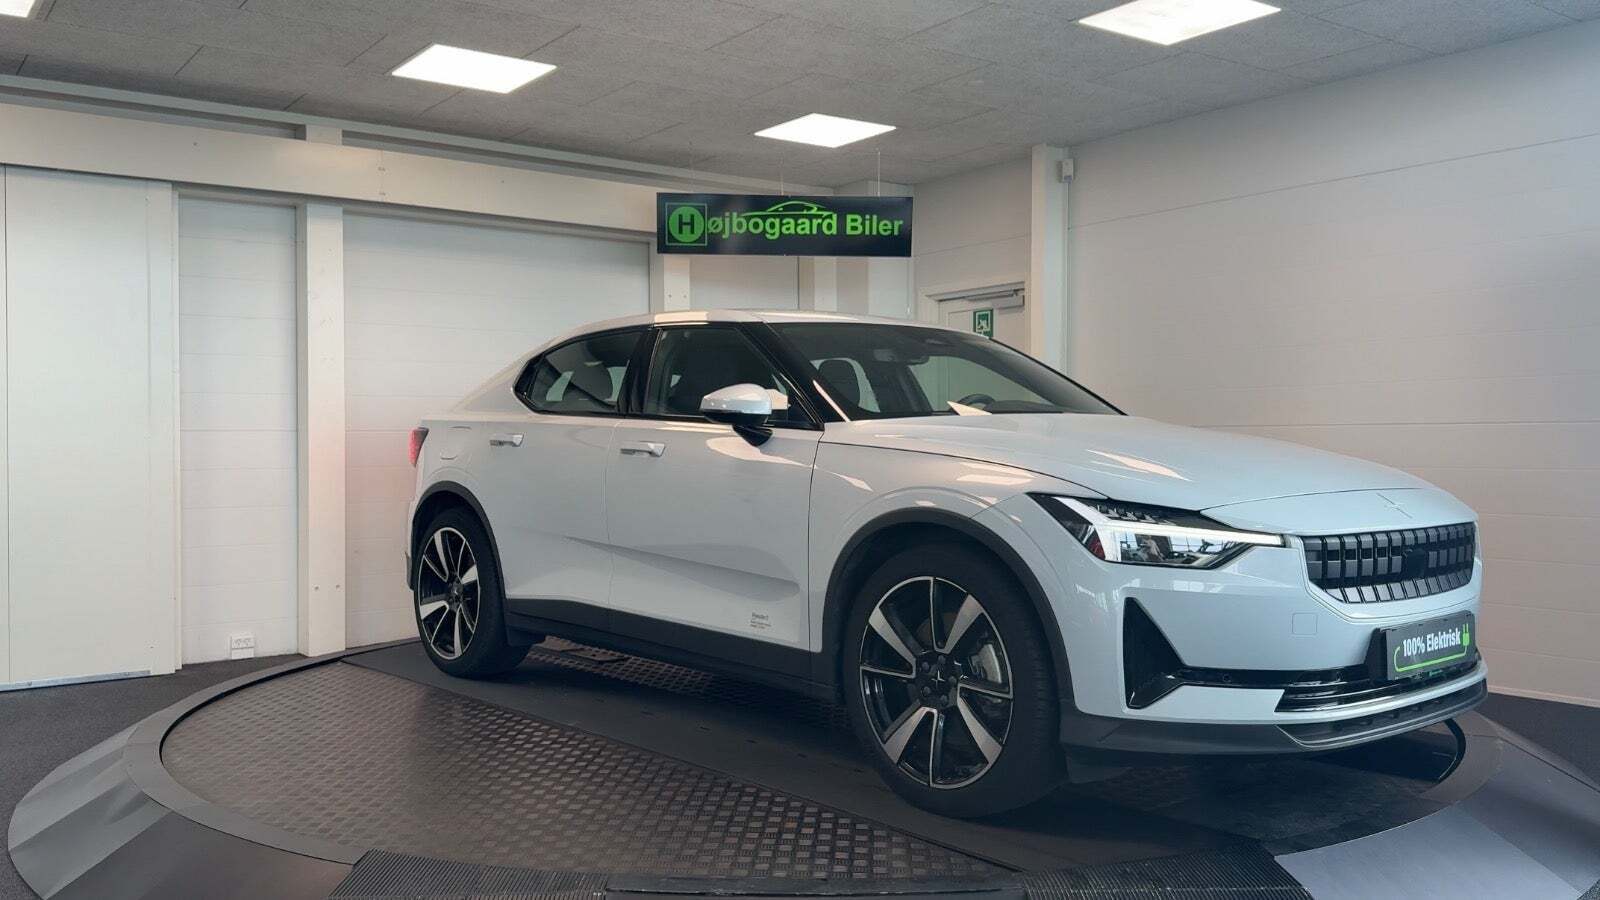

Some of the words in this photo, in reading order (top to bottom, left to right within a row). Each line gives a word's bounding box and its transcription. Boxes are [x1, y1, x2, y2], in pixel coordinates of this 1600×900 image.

[677, 212, 837, 240] Højbogaard
[845, 214, 904, 236] Biler
[1402, 637, 1426, 658] 100%
[1426, 627, 1461, 653] Elektrisk
